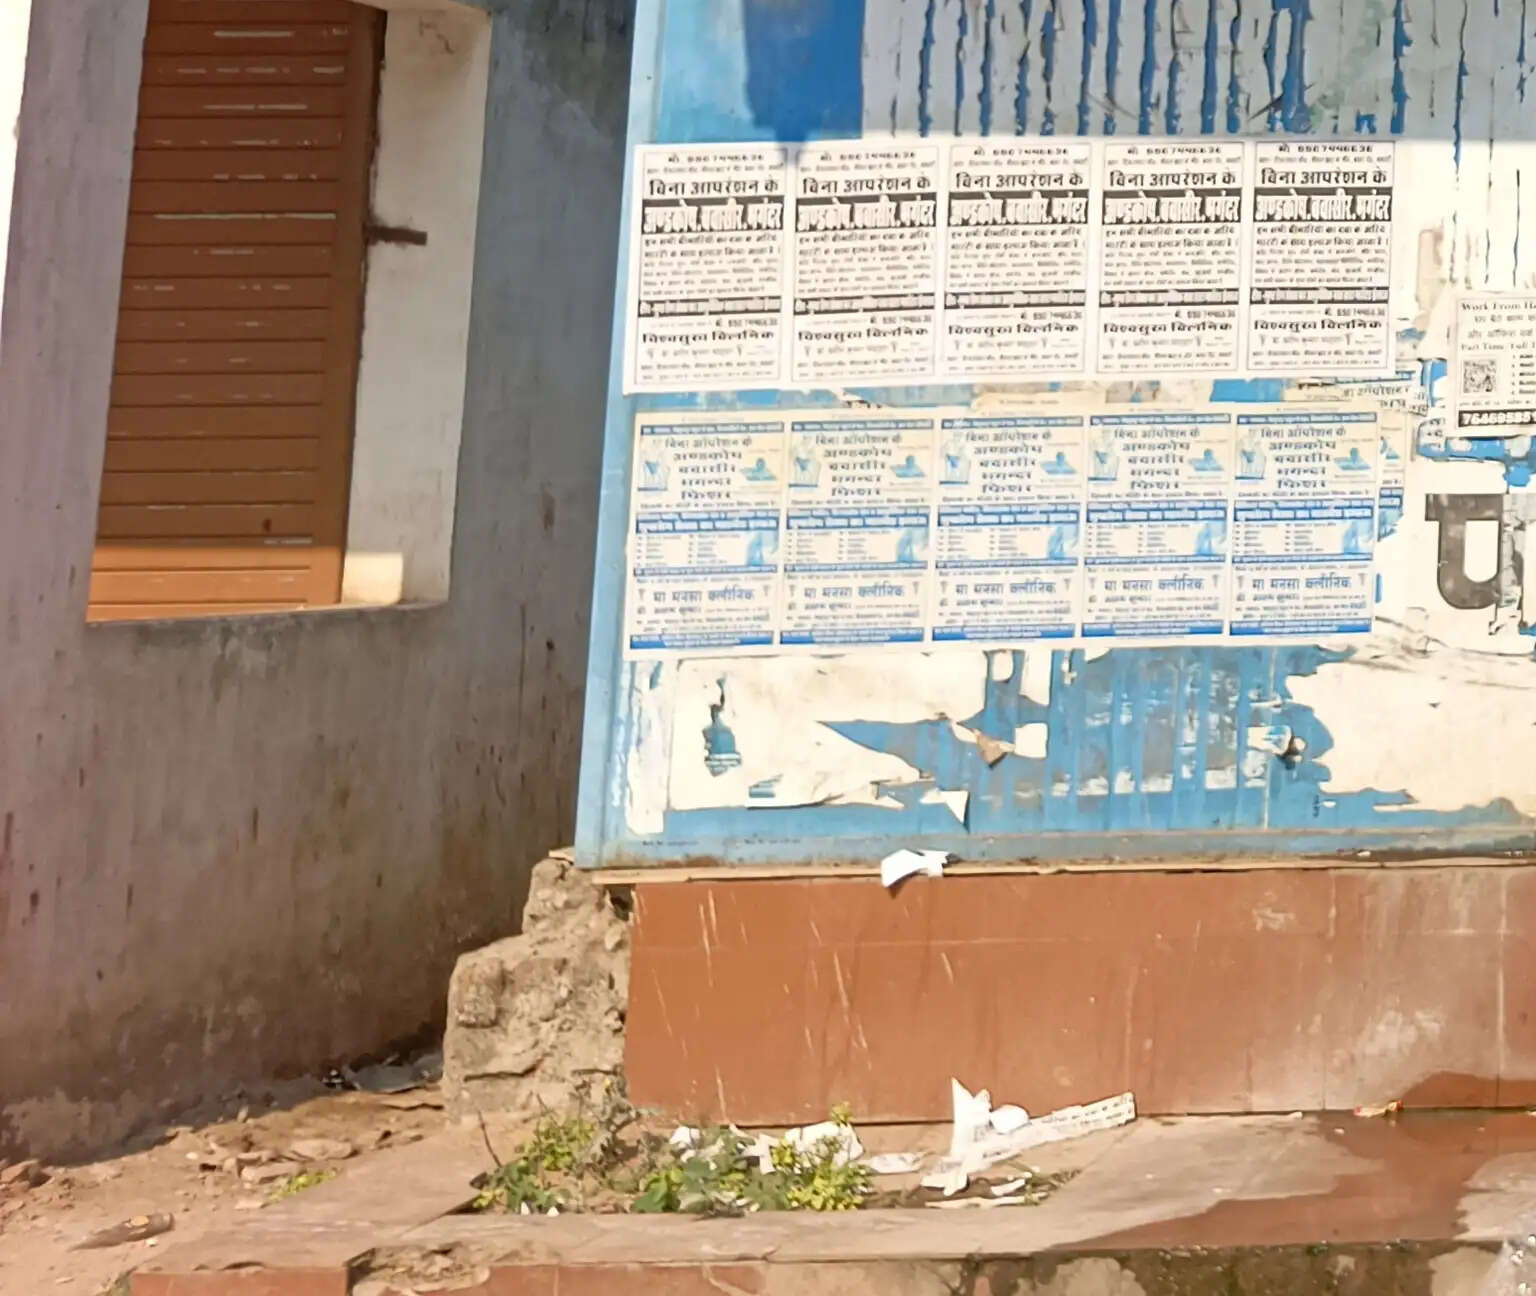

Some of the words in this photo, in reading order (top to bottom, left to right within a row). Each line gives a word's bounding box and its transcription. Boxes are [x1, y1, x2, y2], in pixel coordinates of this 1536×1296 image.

[917, 175, 930, 191] के
[1069, 168, 1082, 185] के
[1222, 168, 1236, 185] के
[1373, 166, 1386, 183] के
[765, 175, 778, 193] के
[1462, 302, 1488, 310] Work
